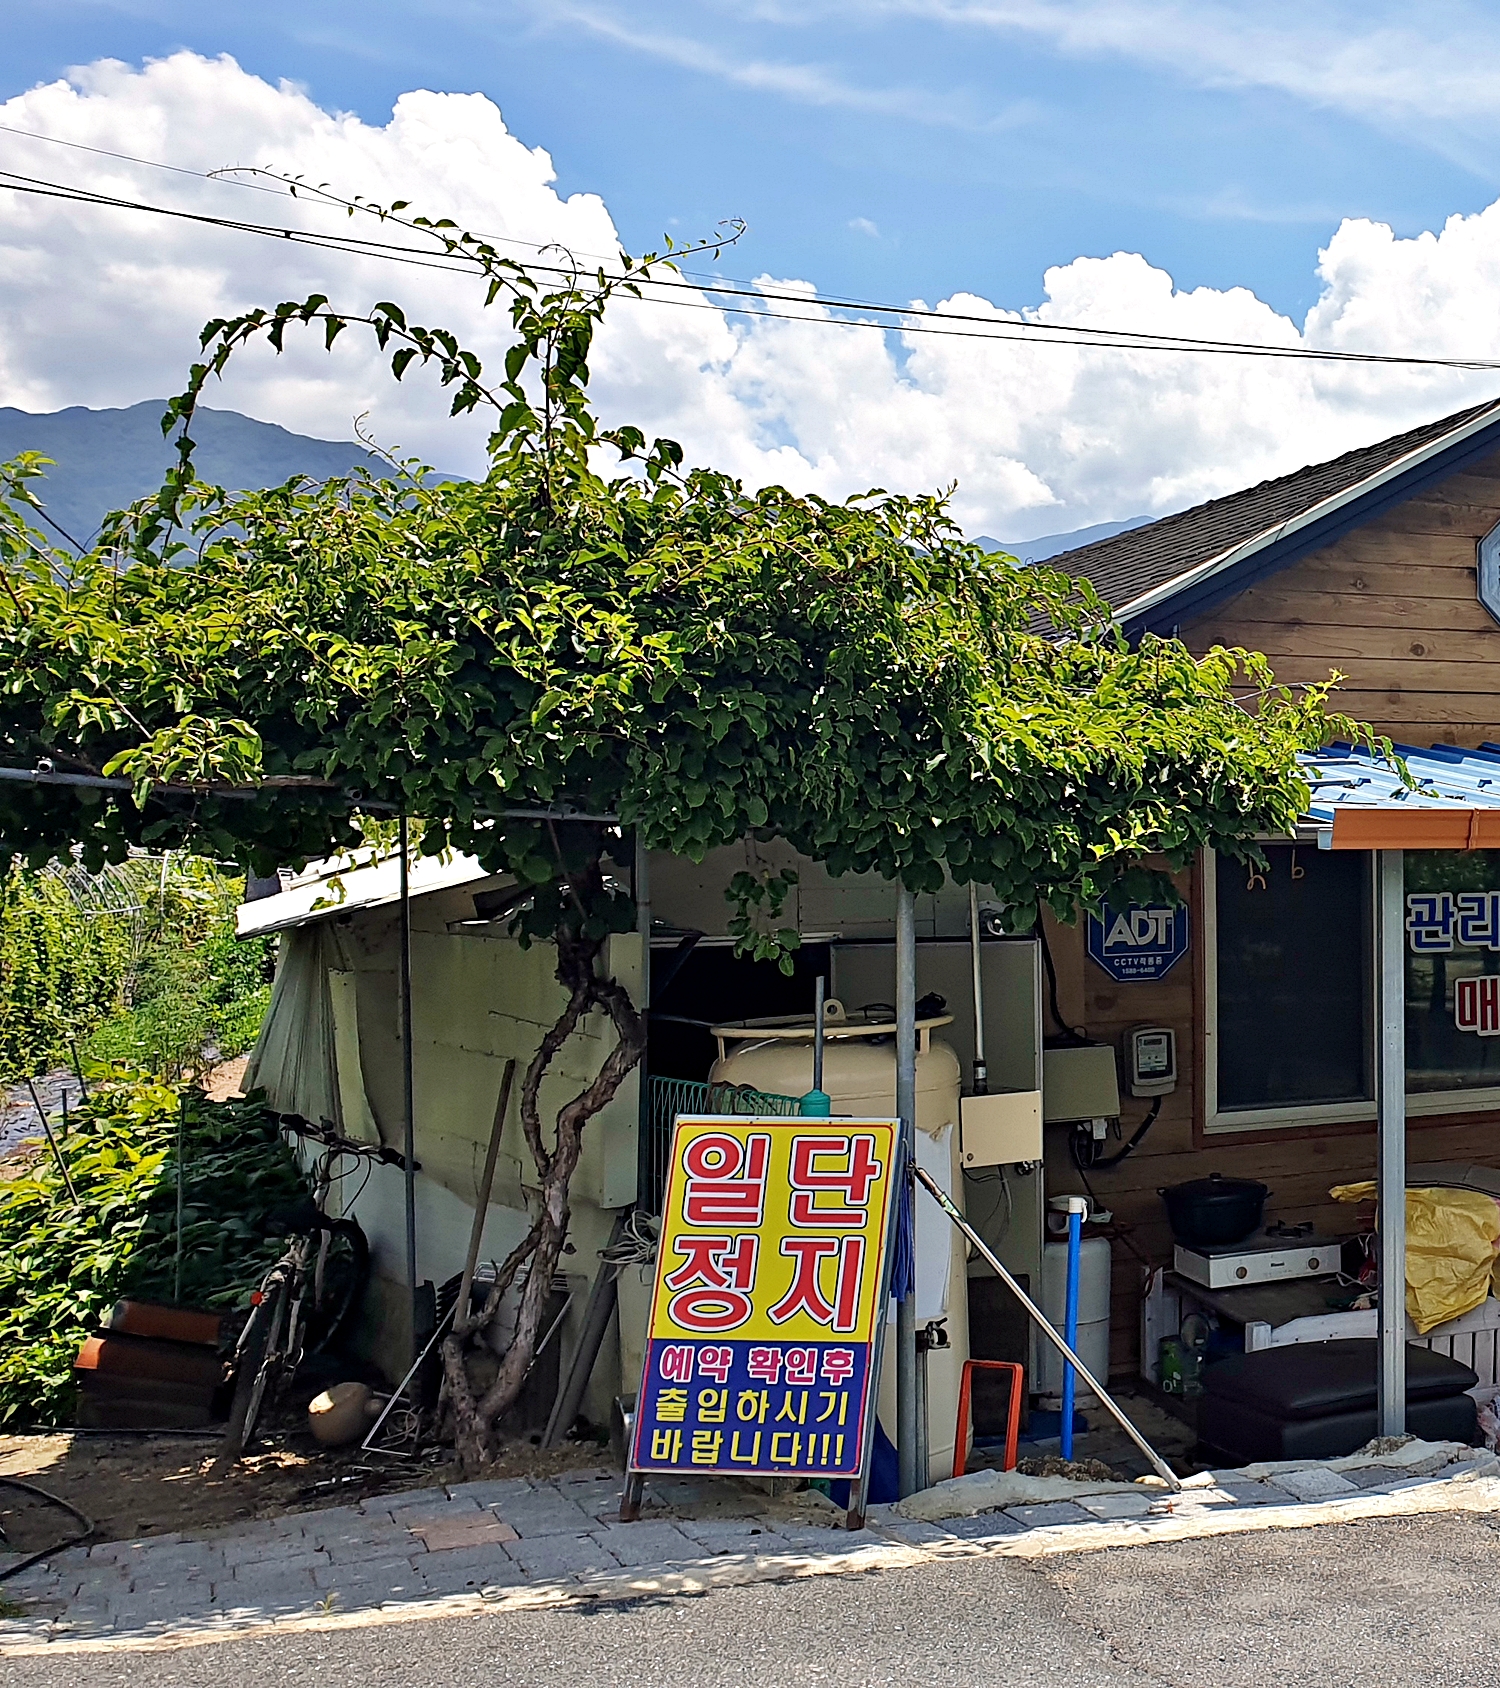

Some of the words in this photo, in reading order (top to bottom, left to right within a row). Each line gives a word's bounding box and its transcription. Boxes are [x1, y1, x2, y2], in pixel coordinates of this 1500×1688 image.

[1104, 910, 1174, 947] ADT
[682, 1132, 882, 1228] 일단
[664, 1234, 867, 1333] 정지
[659, 1345, 731, 1384] 예약
[748, 1346, 854, 1386] 확인후
[655, 1388, 849, 1426] 출입하시기
[650, 1429, 844, 1467] 바랍니다!!!
